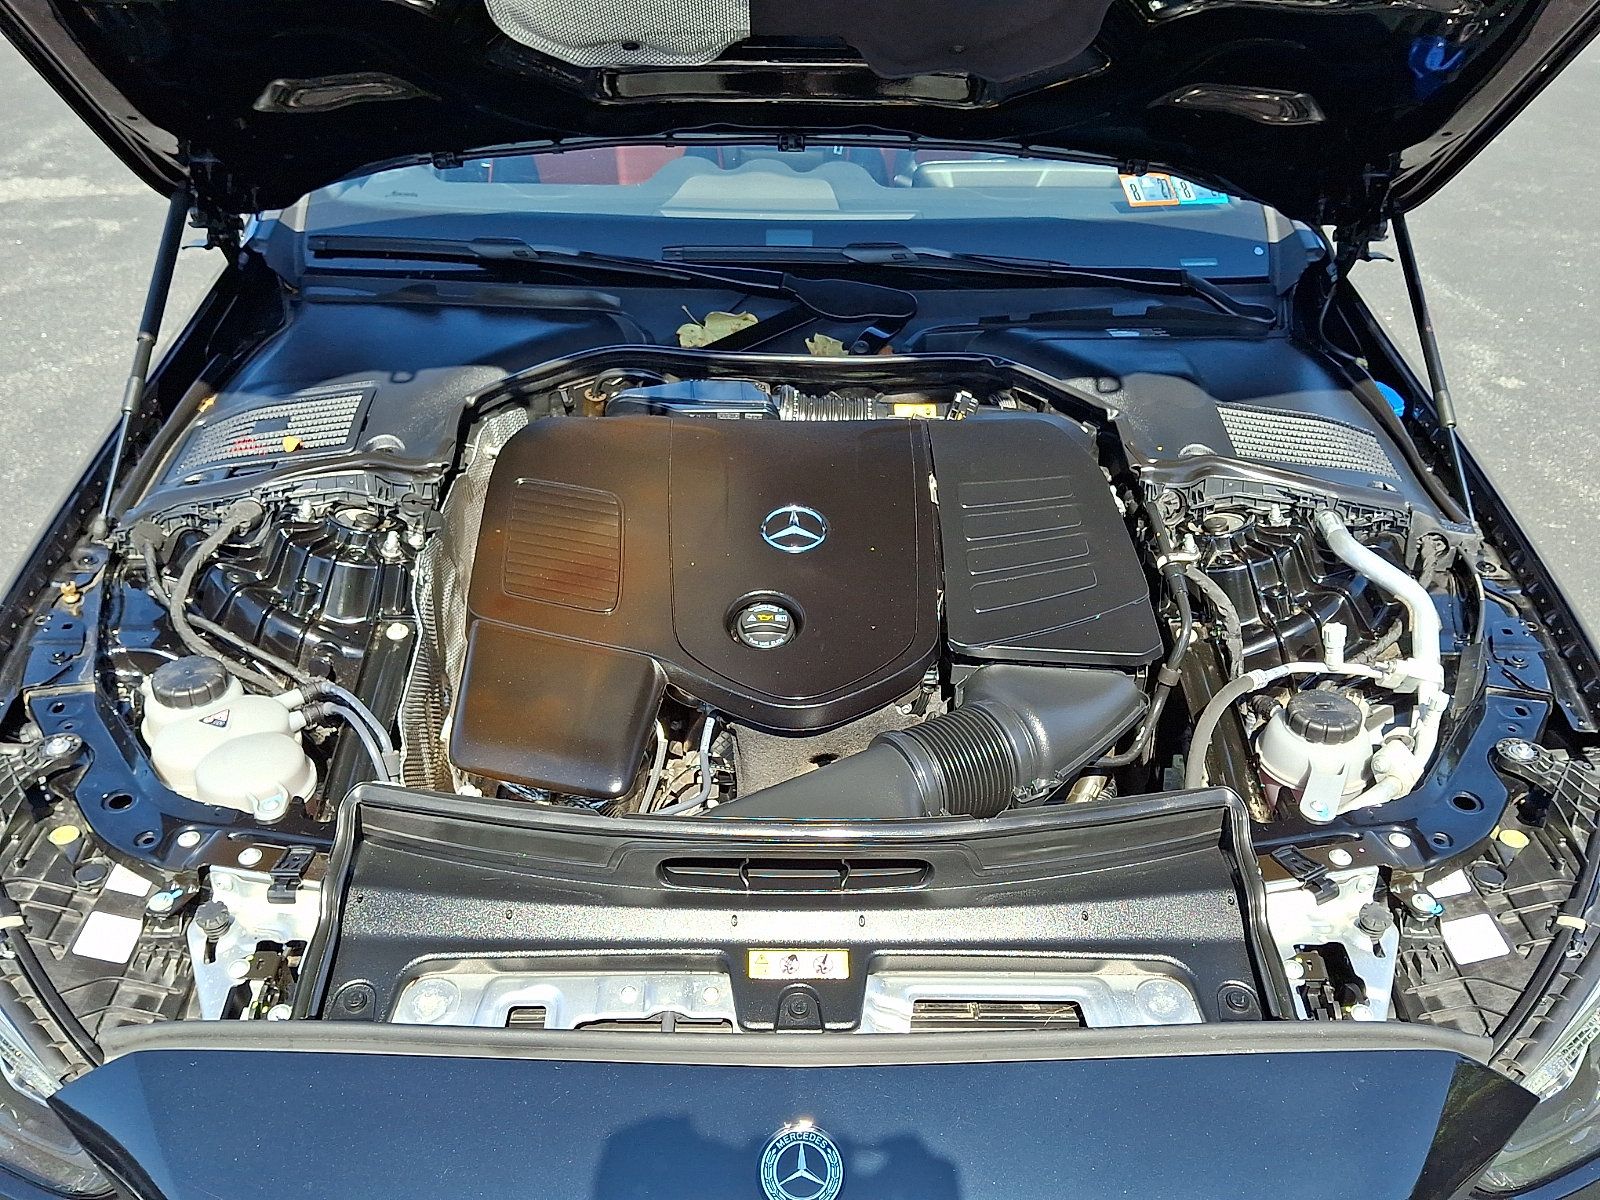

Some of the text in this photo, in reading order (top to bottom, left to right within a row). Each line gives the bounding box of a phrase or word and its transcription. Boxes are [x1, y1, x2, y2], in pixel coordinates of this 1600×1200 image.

[1129, 183, 1141, 201] 8
[1180, 181, 1191, 199] 8
[775, 1132, 828, 1149] MERCEDES
